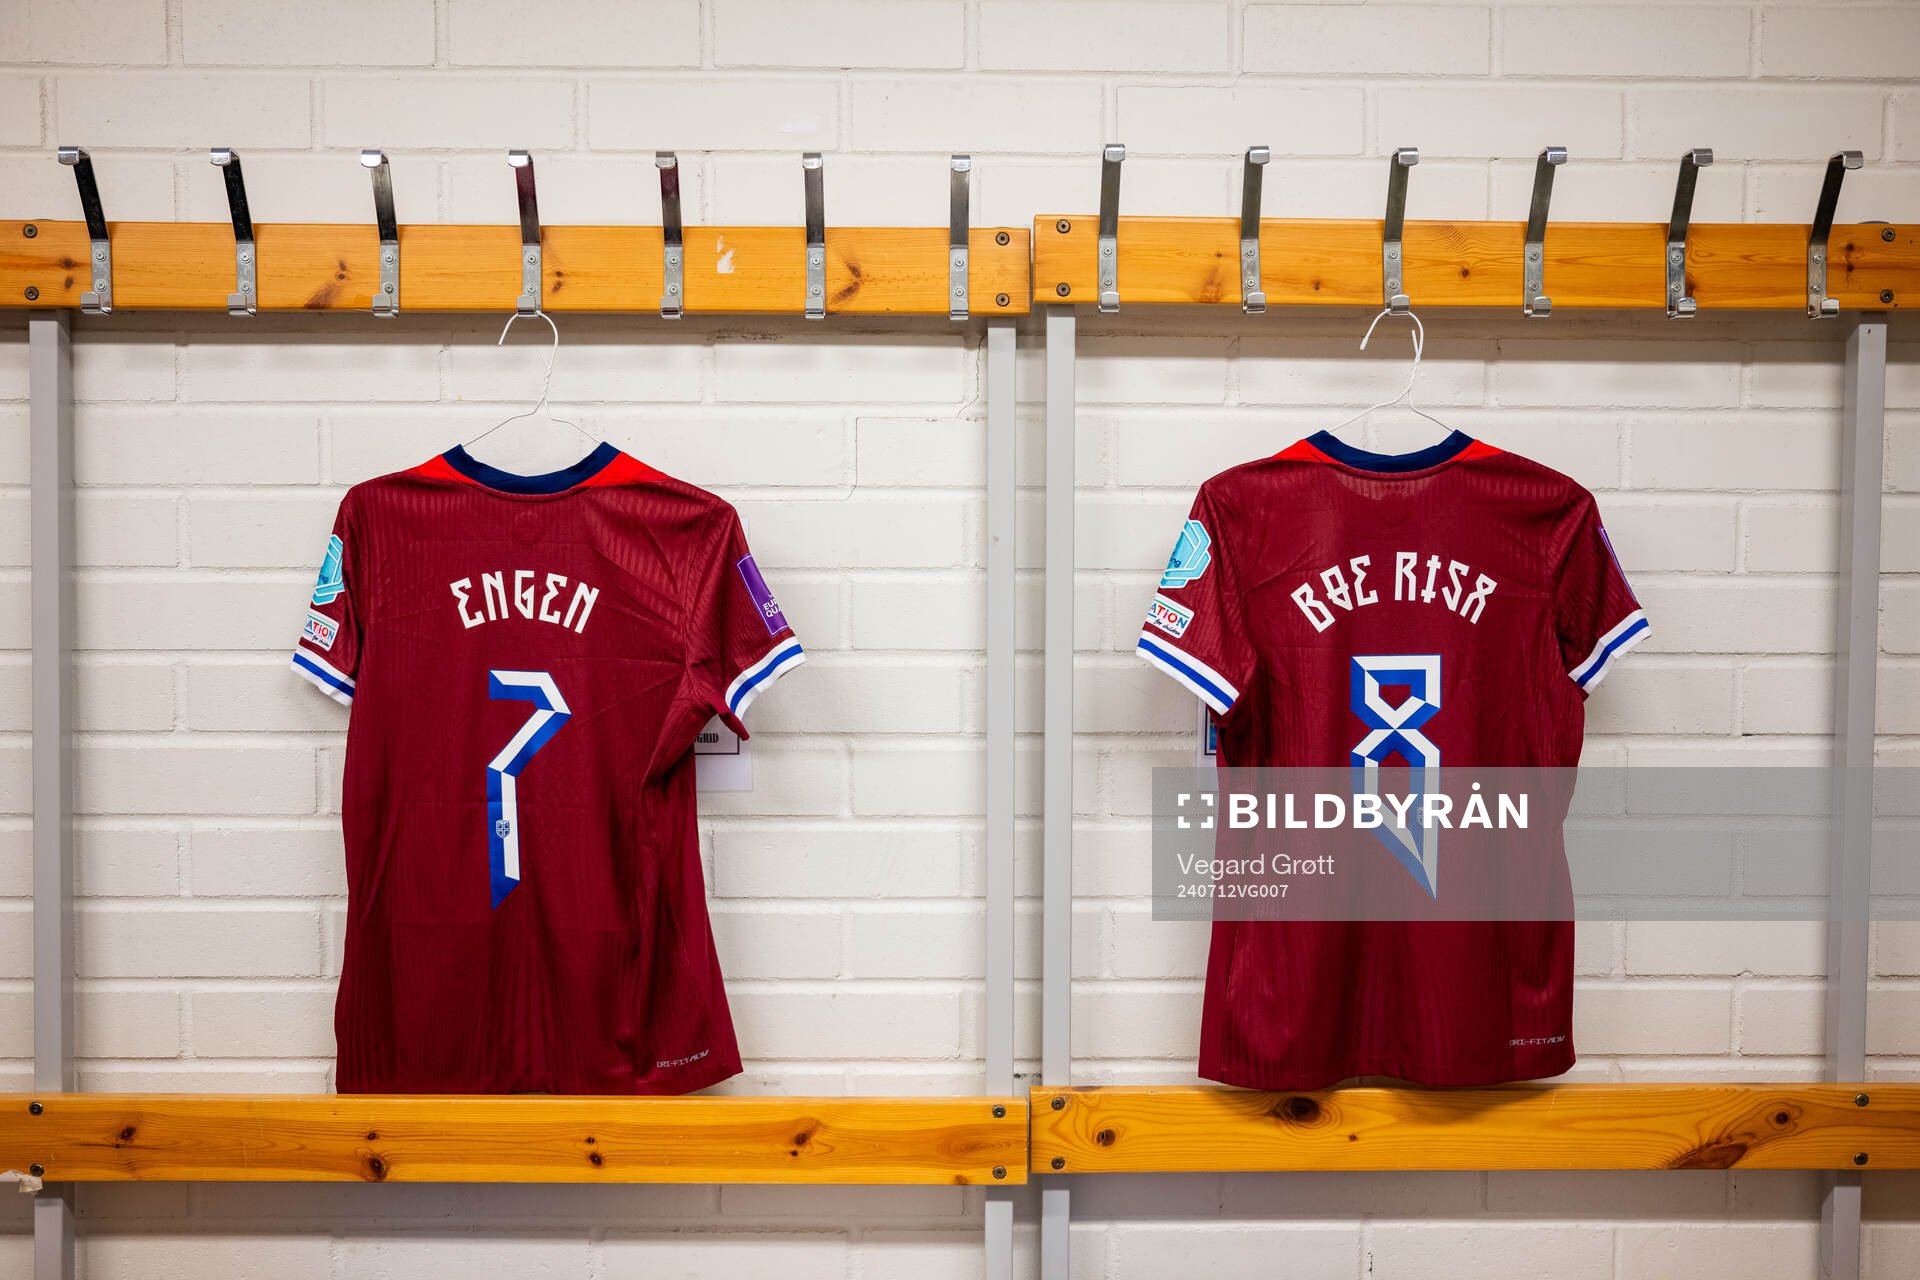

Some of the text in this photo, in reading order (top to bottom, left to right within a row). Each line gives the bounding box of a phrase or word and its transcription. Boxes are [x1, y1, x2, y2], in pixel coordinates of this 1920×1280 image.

[450, 569, 600, 634] ENGEN
[765, 605, 780, 618] QU
[1290, 554, 1379, 633] BØE
[694, 732, 719, 744] GRID
[486, 668, 573, 911] 7
[1350, 653, 1441, 900] 8
